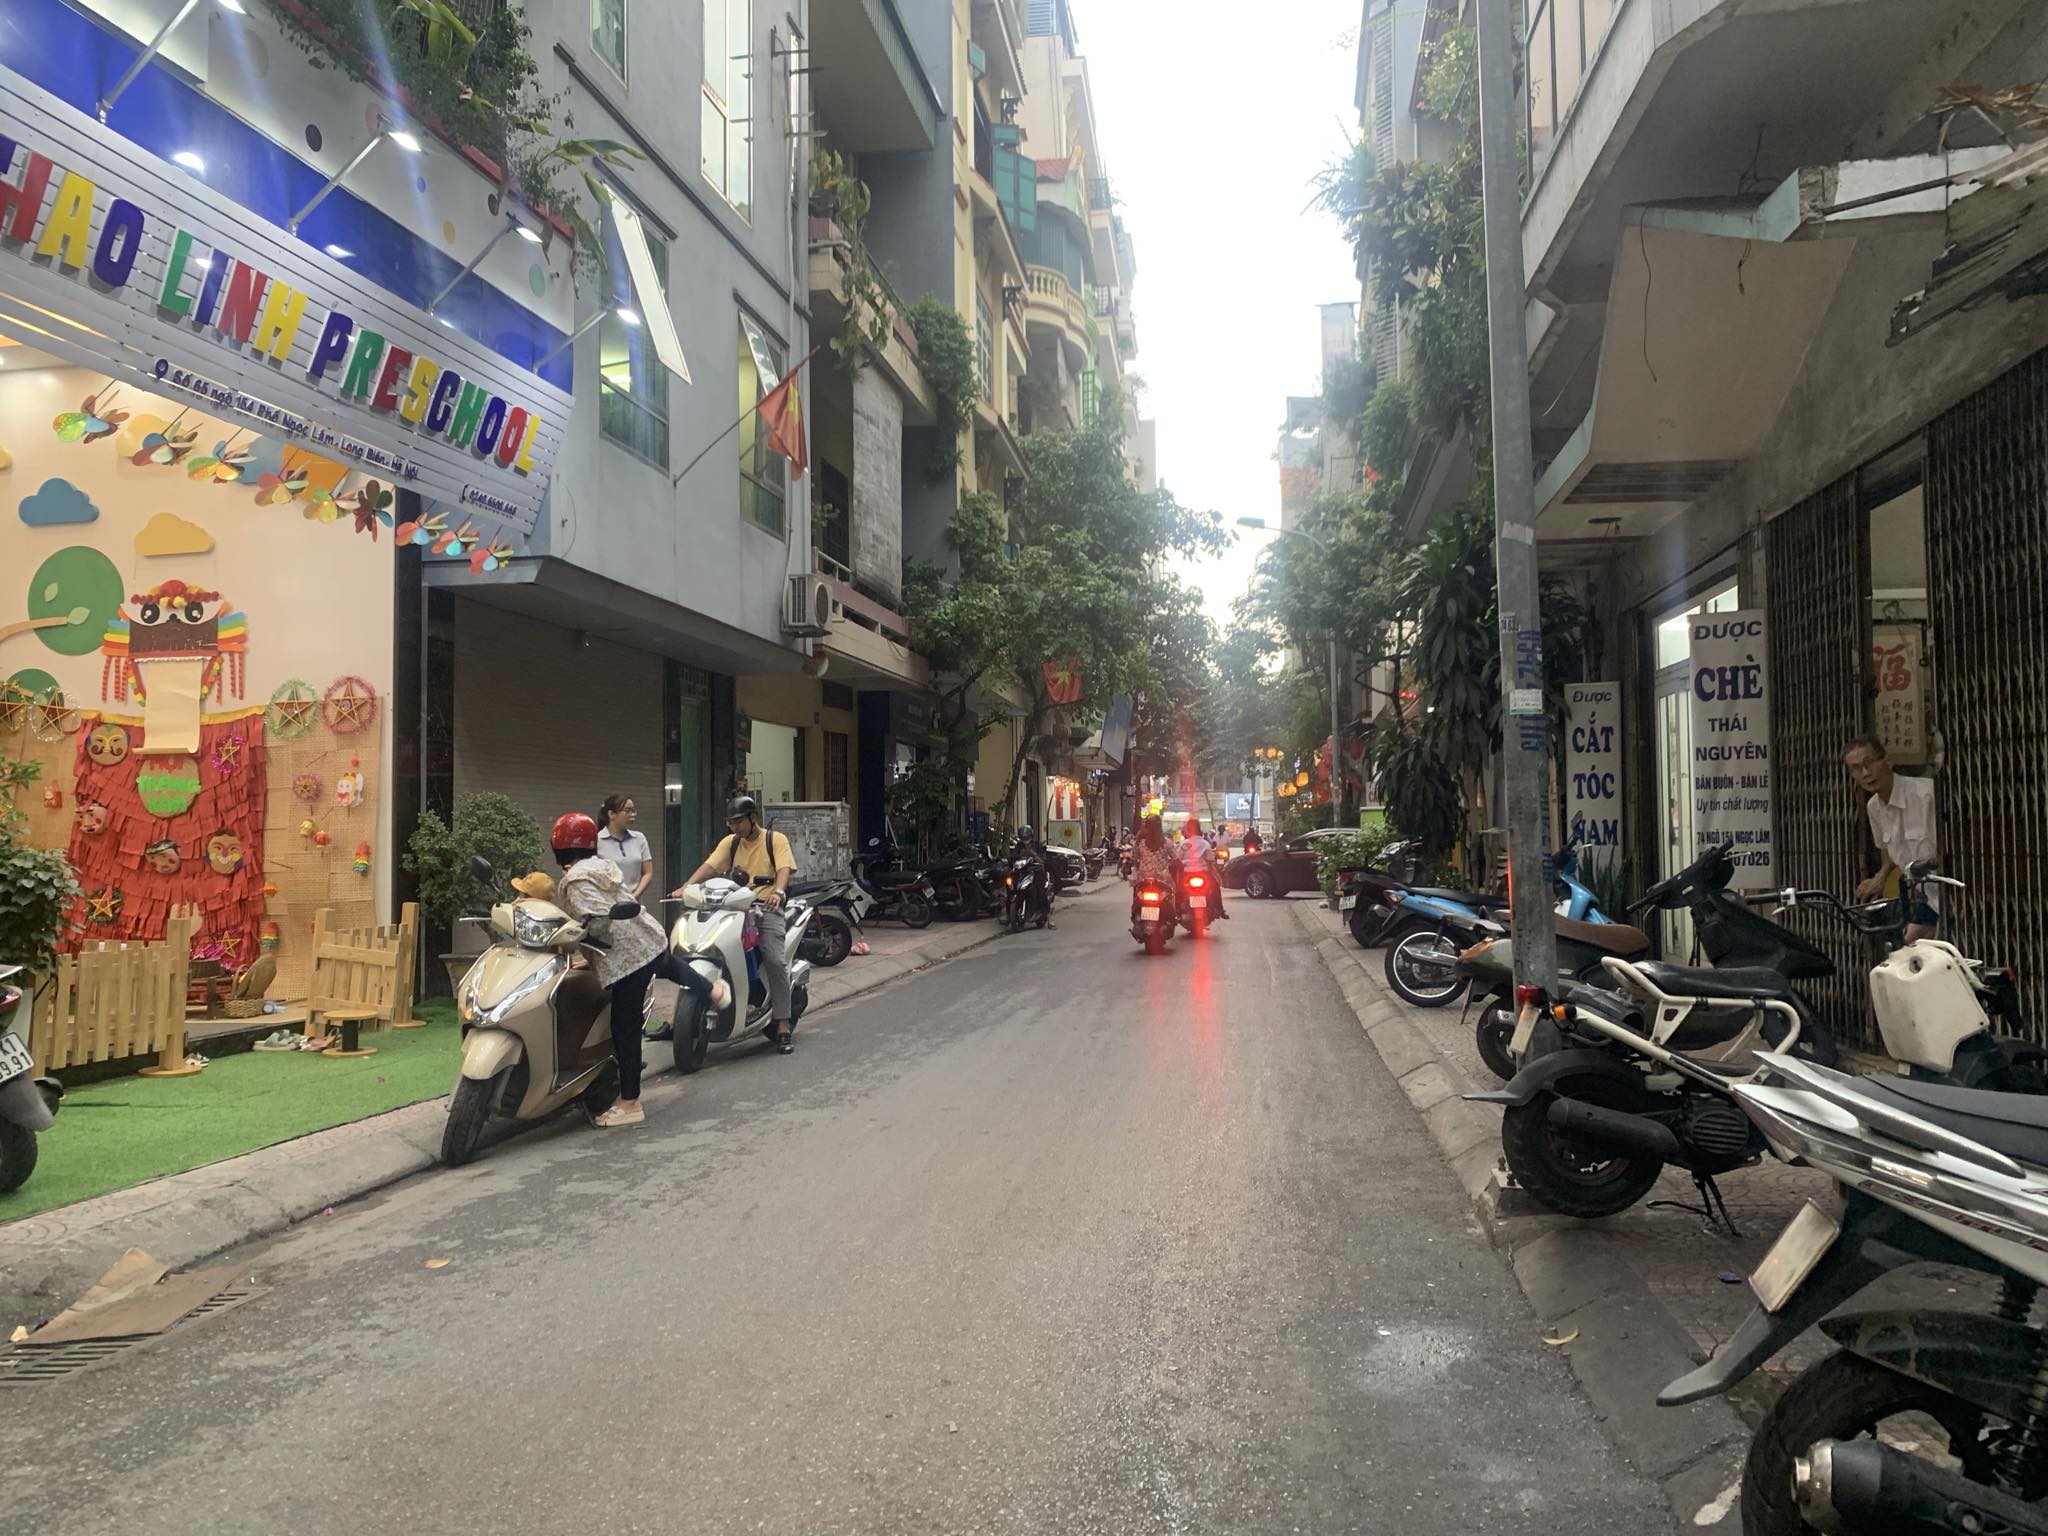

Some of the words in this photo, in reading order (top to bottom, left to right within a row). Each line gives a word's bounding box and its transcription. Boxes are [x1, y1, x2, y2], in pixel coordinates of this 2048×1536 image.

[159, 229, 309, 362] LINH
[308, 311, 541, 474] PRESCHOOL
[193, 380, 209, 395] 65
[234, 396, 254, 413] 154
[257, 404, 281, 423] Phố
[341, 438, 363, 458] Long
[1694, 621, 1762, 642] ĐƯỢC
[1694, 654, 1763, 702] CHÈ
[1573, 690, 1612, 704] Được
[1572, 711, 1614, 753] CẮT
[1708, 713, 1747, 732] THÁI
[1695, 741, 1767, 760] NGUYÊN
[1573, 764, 1615, 799] TÓC
[1695, 774, 1711, 790] BÁN
[1713, 774, 1734, 789] BUÔN
[1741, 772, 1758, 789] BÁN
[1760, 769, 1769, 788] LẺ
[1696, 798, 1709, 814] Uy
[1710, 798, 1721, 812] tín
[1722, 797, 1742, 811] chất
[1743, 798, 1768, 813] lượng
[1735, 830, 1755, 846] NGỌC
[1756, 828, 1770, 844] LÂM
